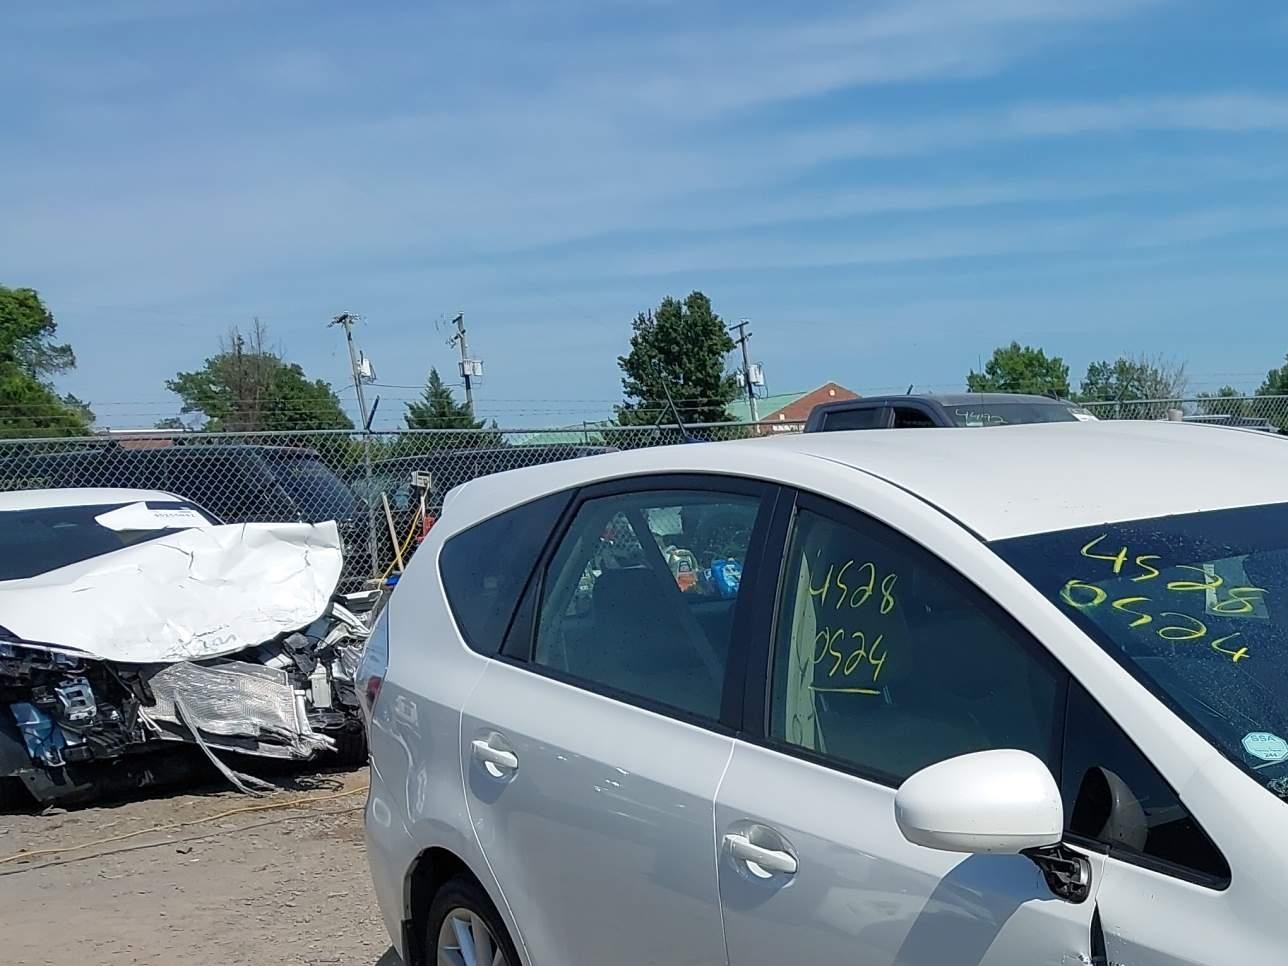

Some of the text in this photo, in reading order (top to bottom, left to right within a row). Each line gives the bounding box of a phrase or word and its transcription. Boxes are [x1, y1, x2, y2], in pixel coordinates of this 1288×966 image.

[809, 559, 898, 615] 4528
[1080, 532, 1270, 613] 4528
[812, 626, 888, 682] 0524
[1059, 579, 1250, 663] 0524
